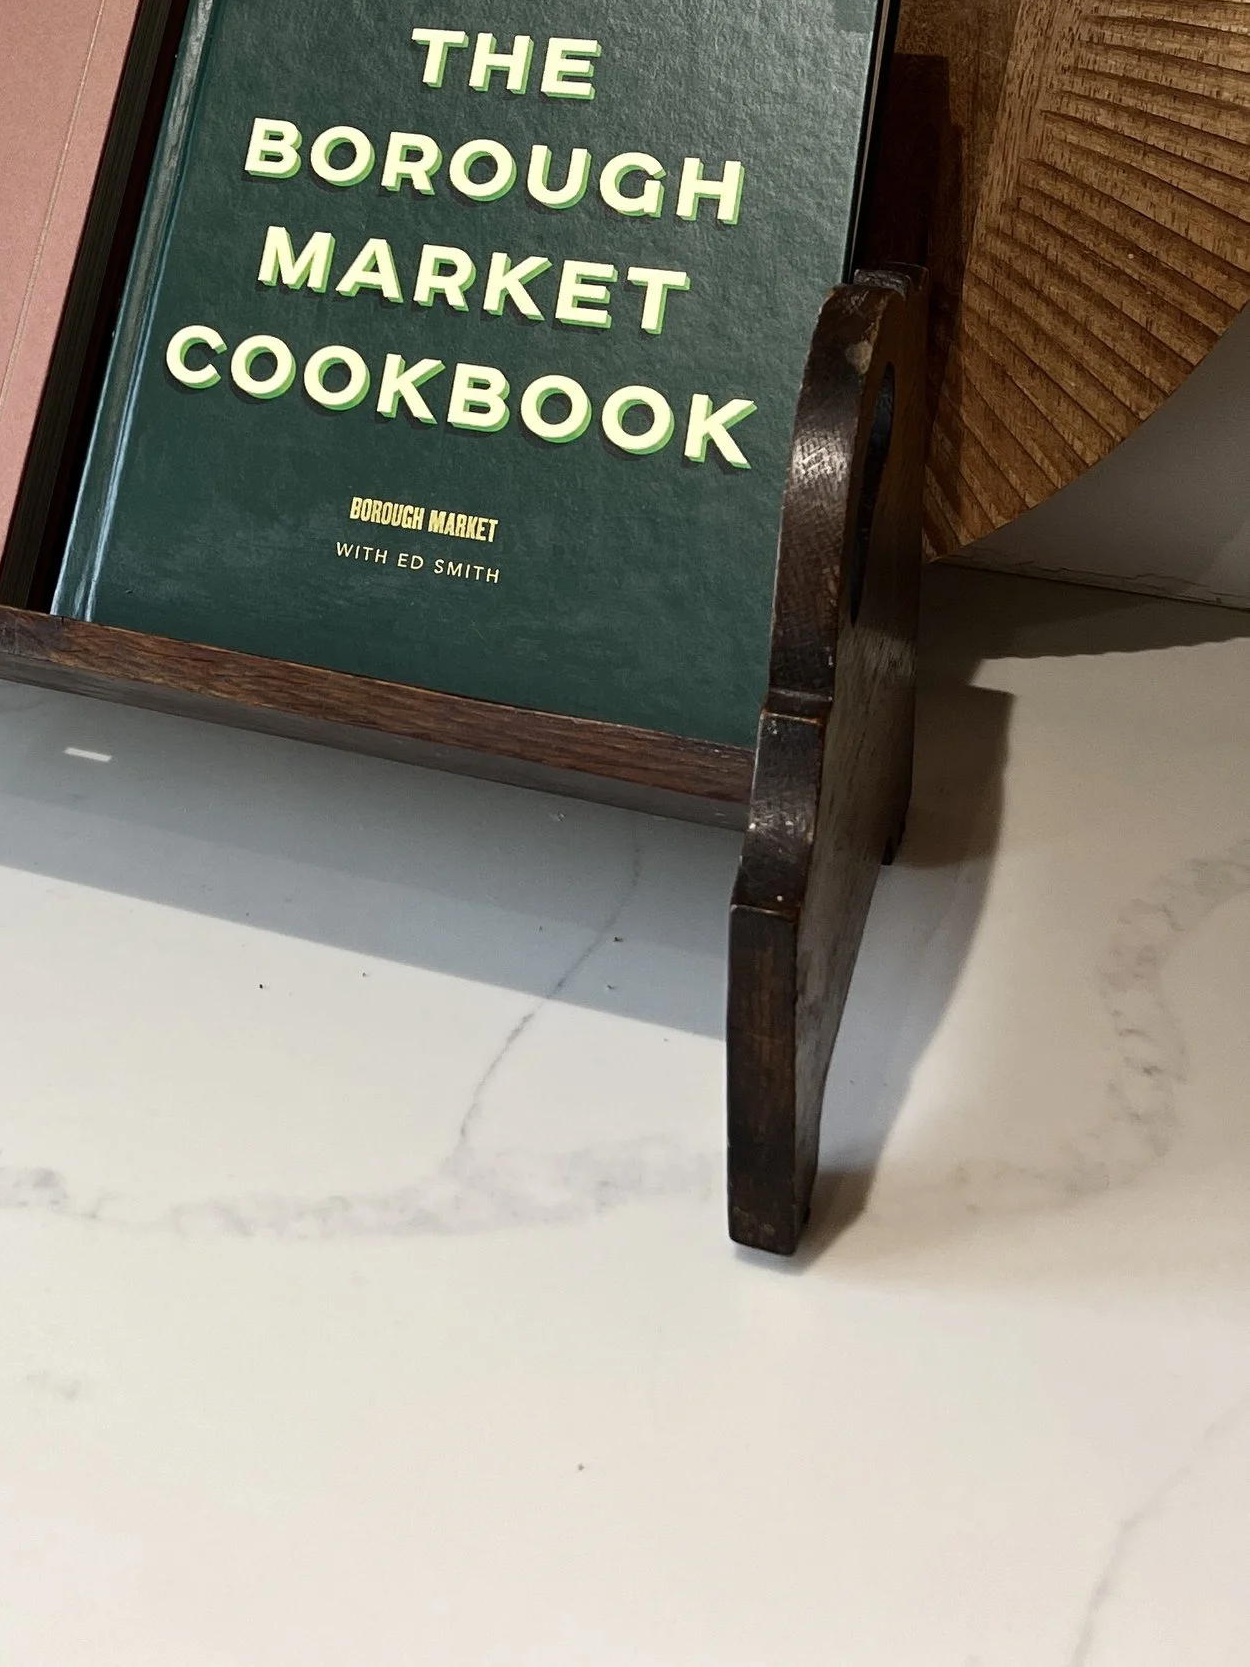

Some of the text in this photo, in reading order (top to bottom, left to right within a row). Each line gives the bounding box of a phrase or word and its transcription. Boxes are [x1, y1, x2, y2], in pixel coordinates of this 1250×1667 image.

[411, 27, 602, 100] THE
[243, 116, 746, 226] BOROUGH
[256, 225, 691, 335] MARKET
[164, 323, 757, 470] COOKBOOK
[335, 540, 500, 584] WITH ED SMITH
[349, 496, 499, 543] BOROUGH MARKET
